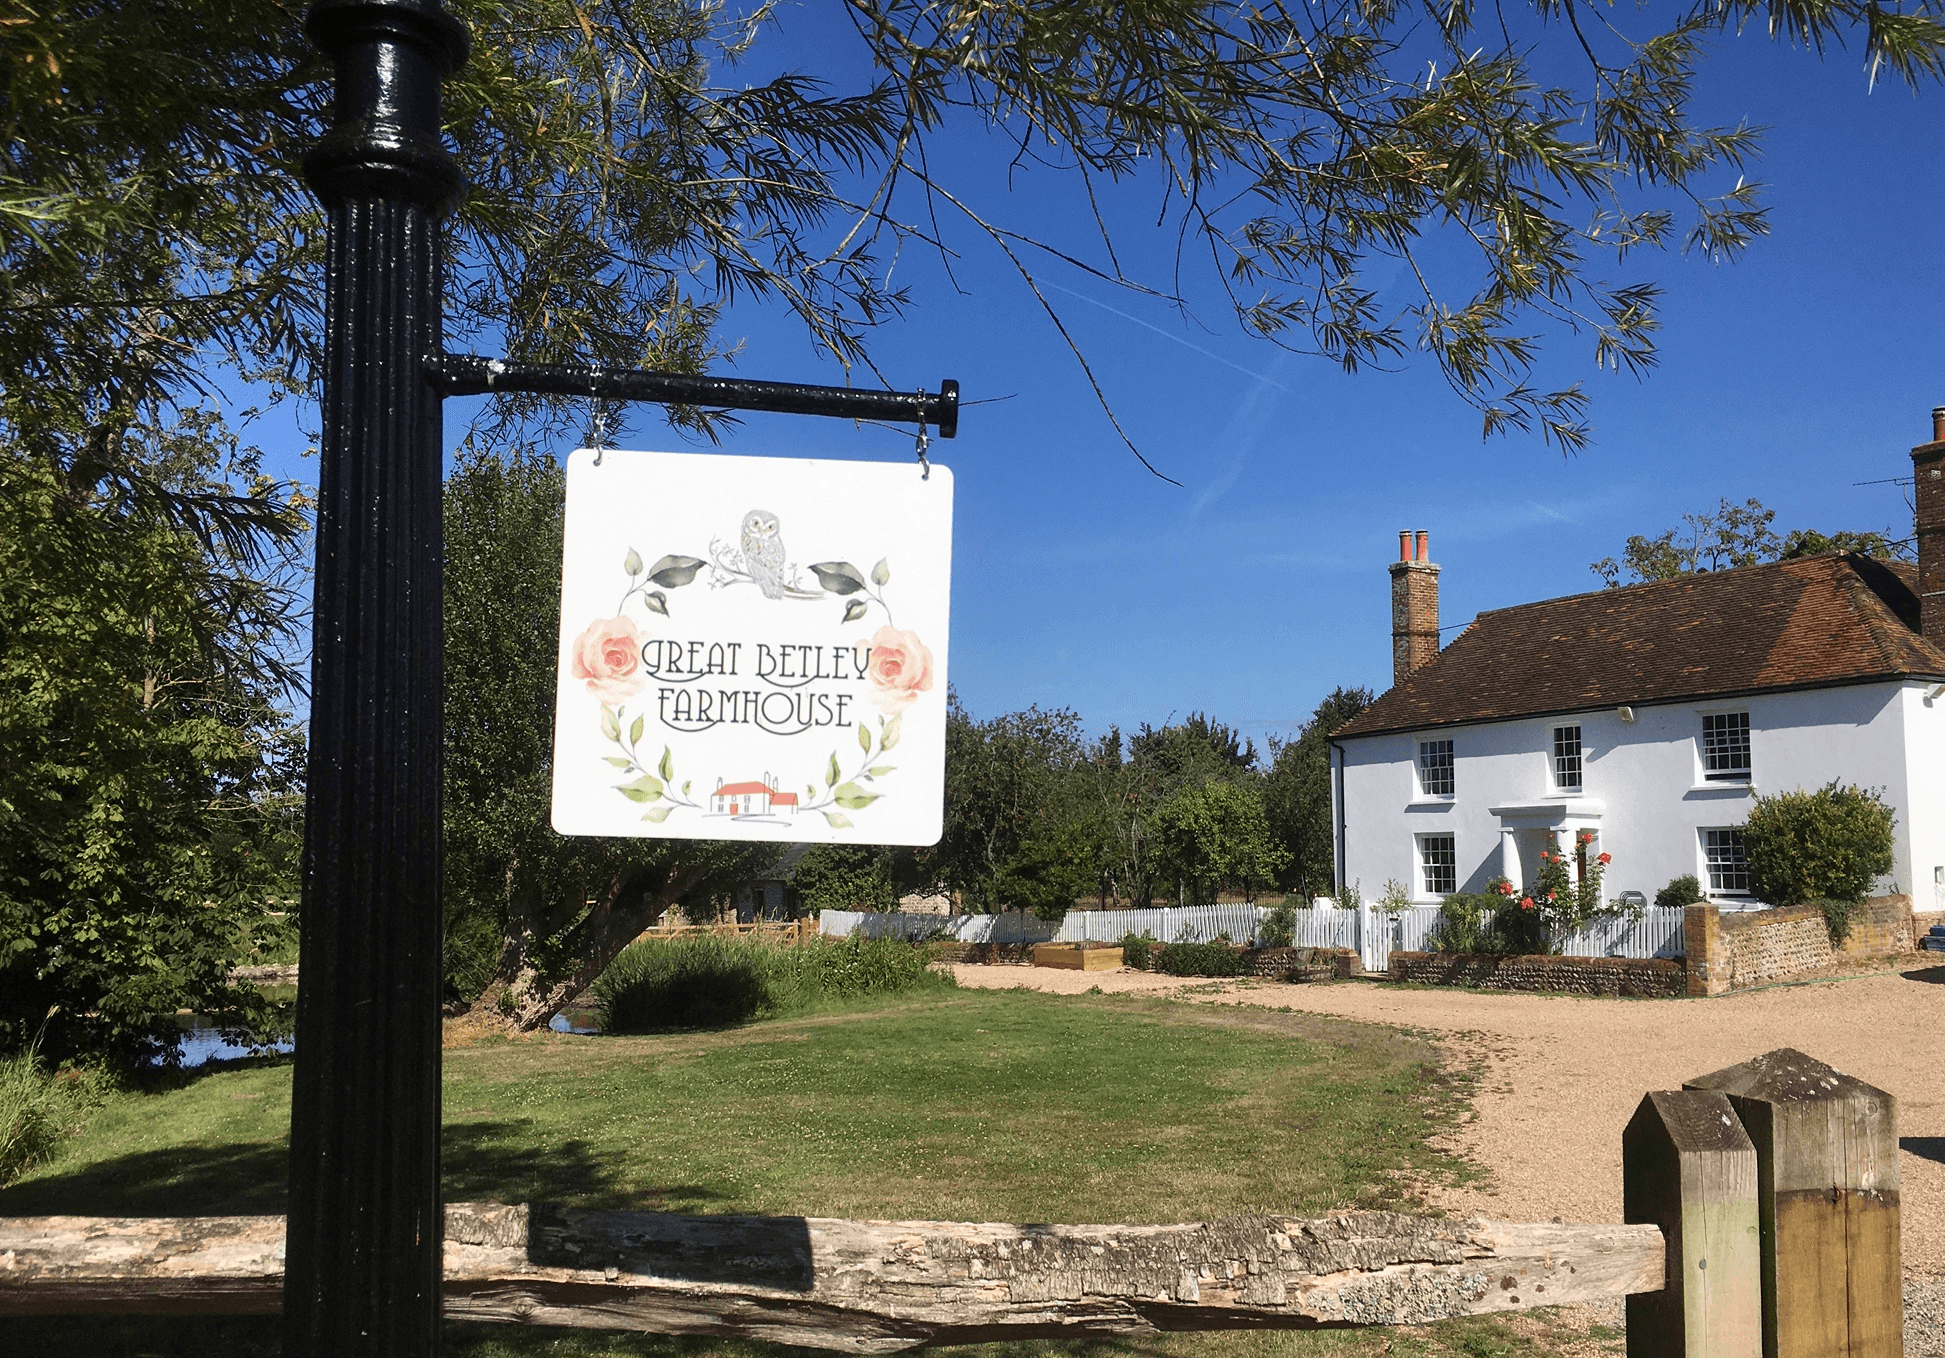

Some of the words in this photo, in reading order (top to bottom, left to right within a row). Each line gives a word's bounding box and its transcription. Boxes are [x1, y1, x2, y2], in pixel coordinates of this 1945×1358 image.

[641, 639, 742, 683] GREAT
[755, 643, 873, 688] BETLEY
[657, 687, 853, 736] FARMHOUSE
